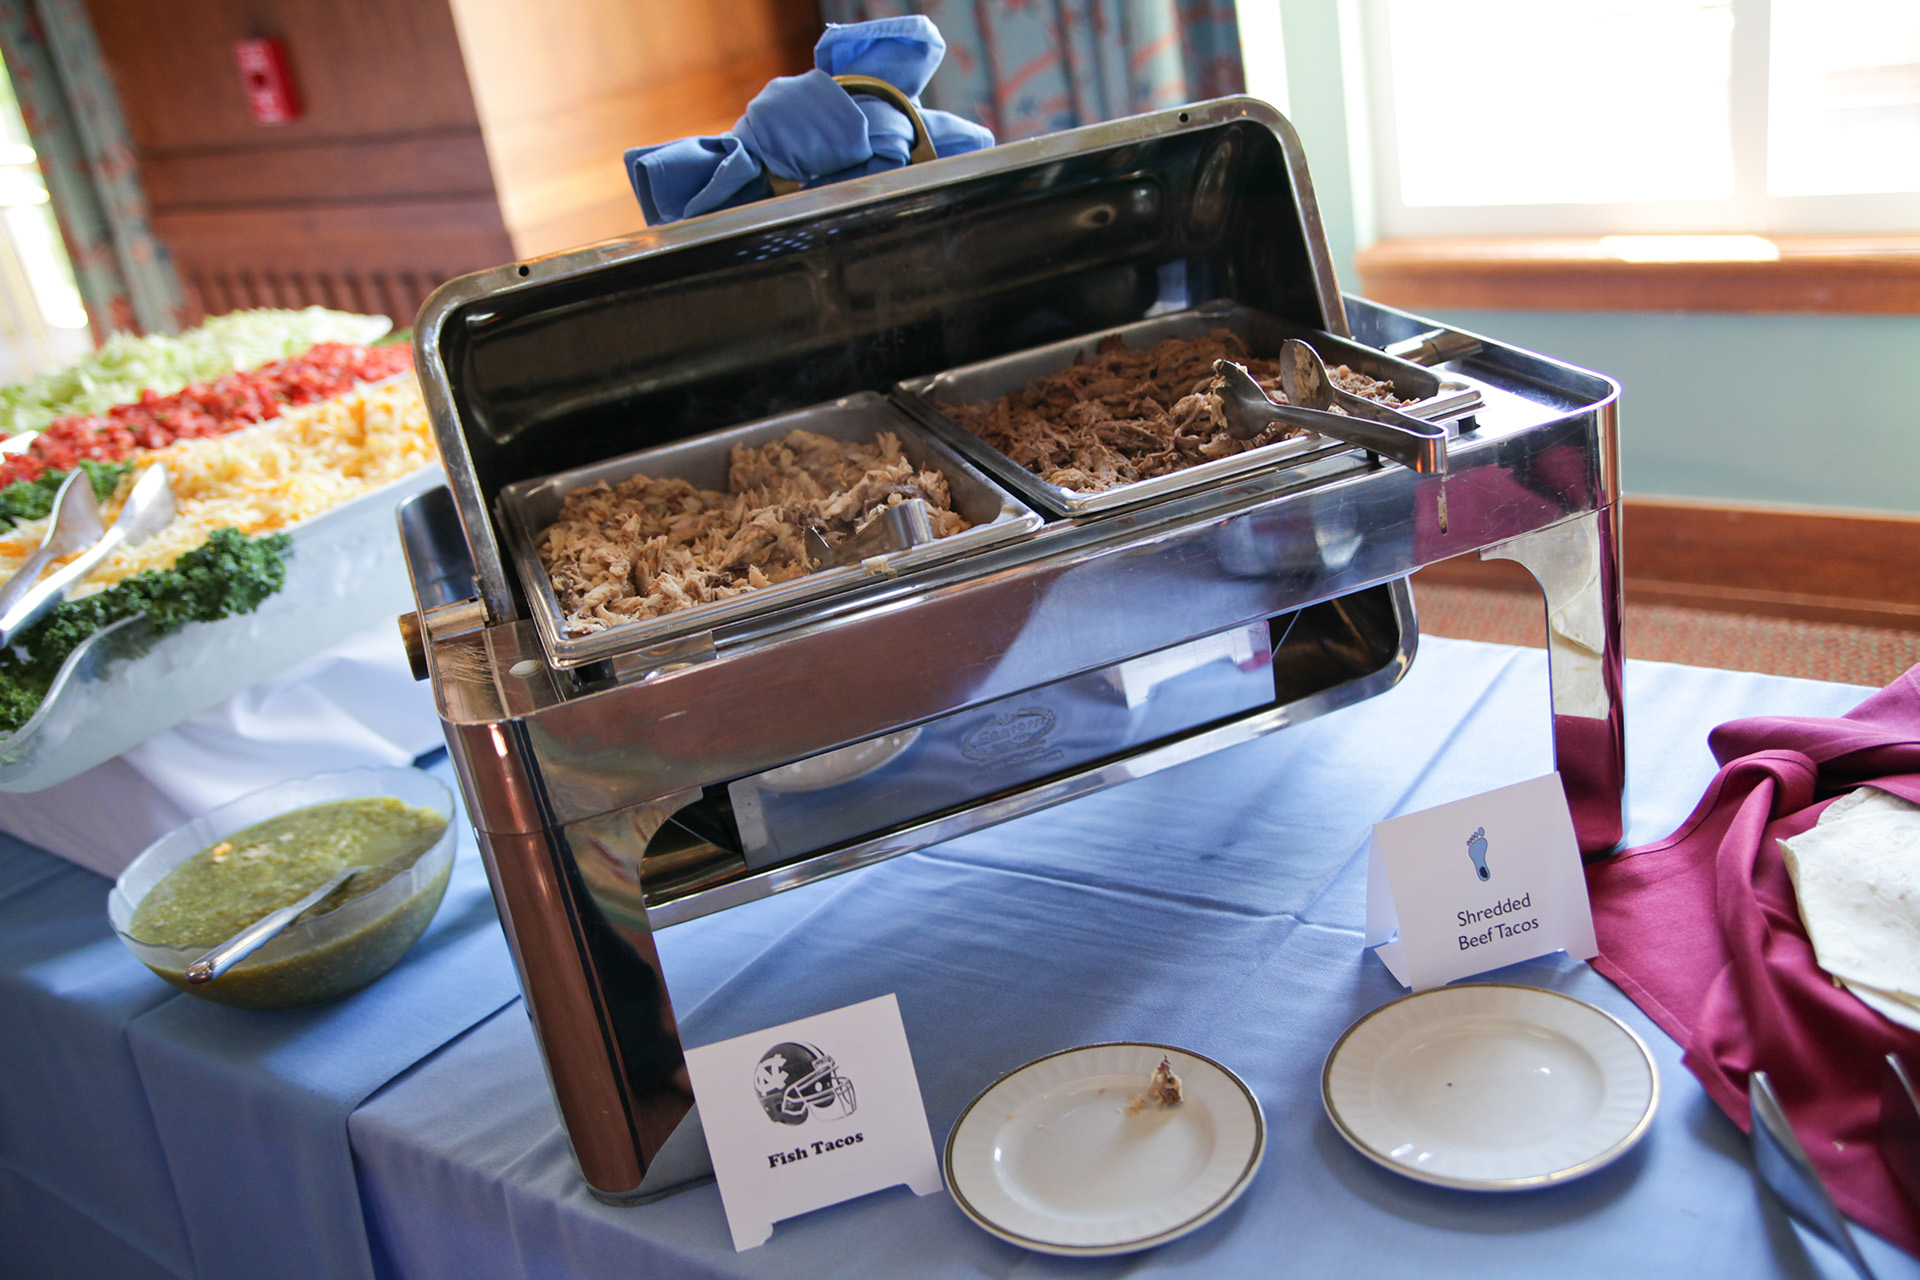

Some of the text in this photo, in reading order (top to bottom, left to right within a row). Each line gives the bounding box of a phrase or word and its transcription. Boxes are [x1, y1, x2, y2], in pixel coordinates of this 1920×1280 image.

[1457, 892, 1531, 927] Shredded
[1458, 918, 1539, 951] Beef Tacos
[767, 1132, 864, 1168] Fish Tacos
